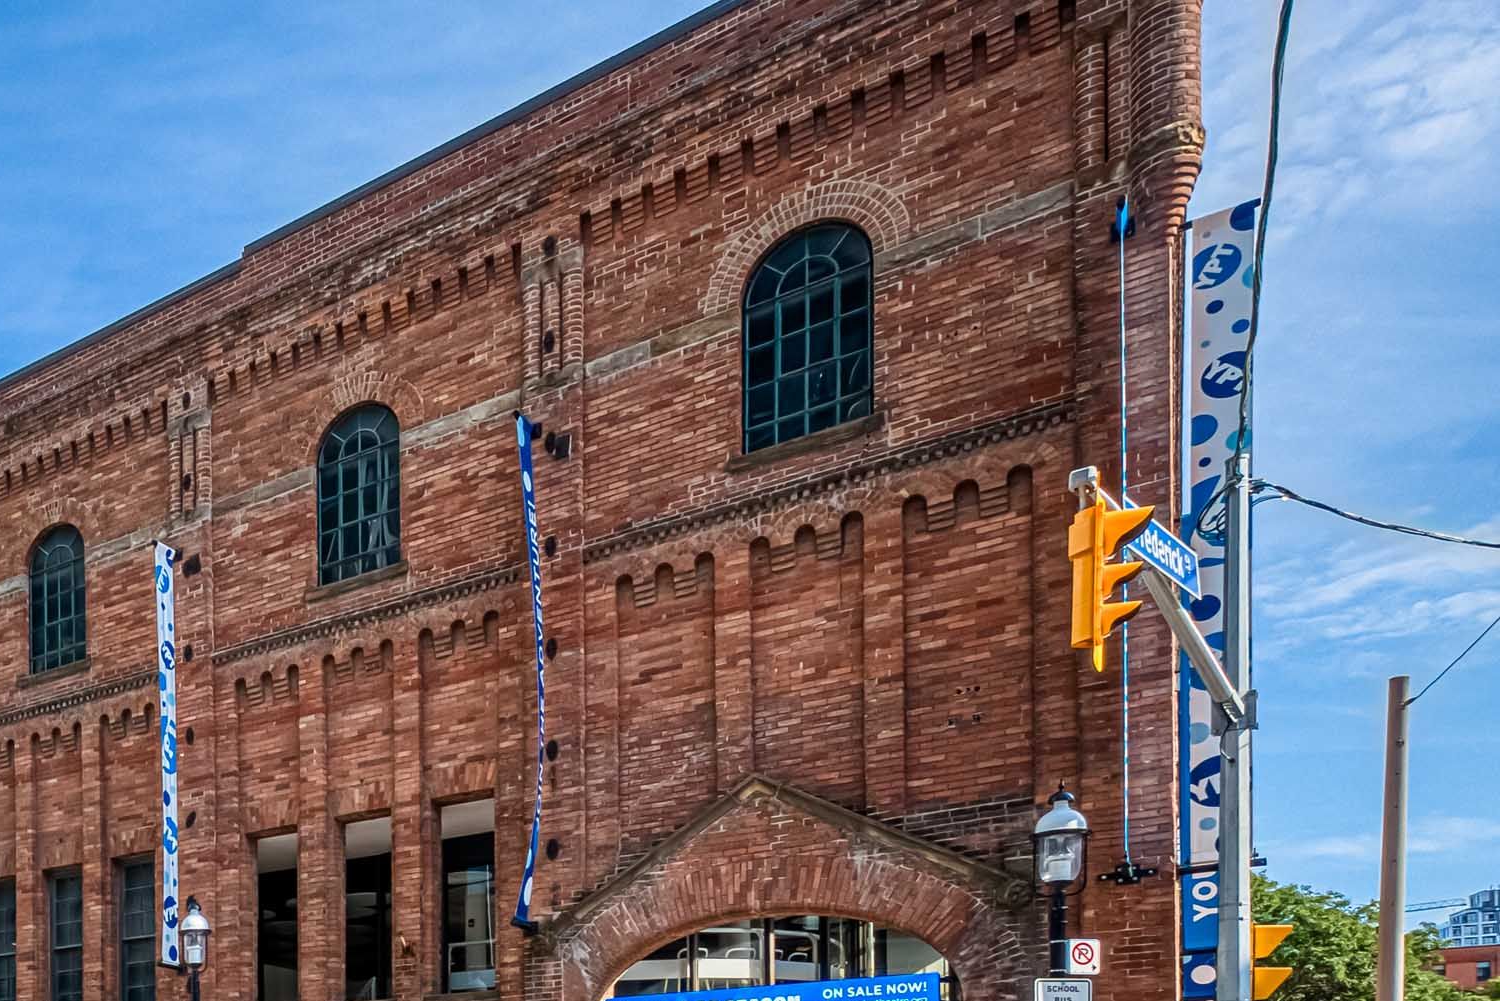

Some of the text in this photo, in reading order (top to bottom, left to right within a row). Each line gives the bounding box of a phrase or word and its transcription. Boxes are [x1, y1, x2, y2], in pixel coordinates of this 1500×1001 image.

[1192, 243, 1234, 289] YPT
[1135, 528, 1185, 579] rederick
[822, 981, 927, 999] ON SALE NOW!
[1046, 985, 1080, 993] SCHOOL
